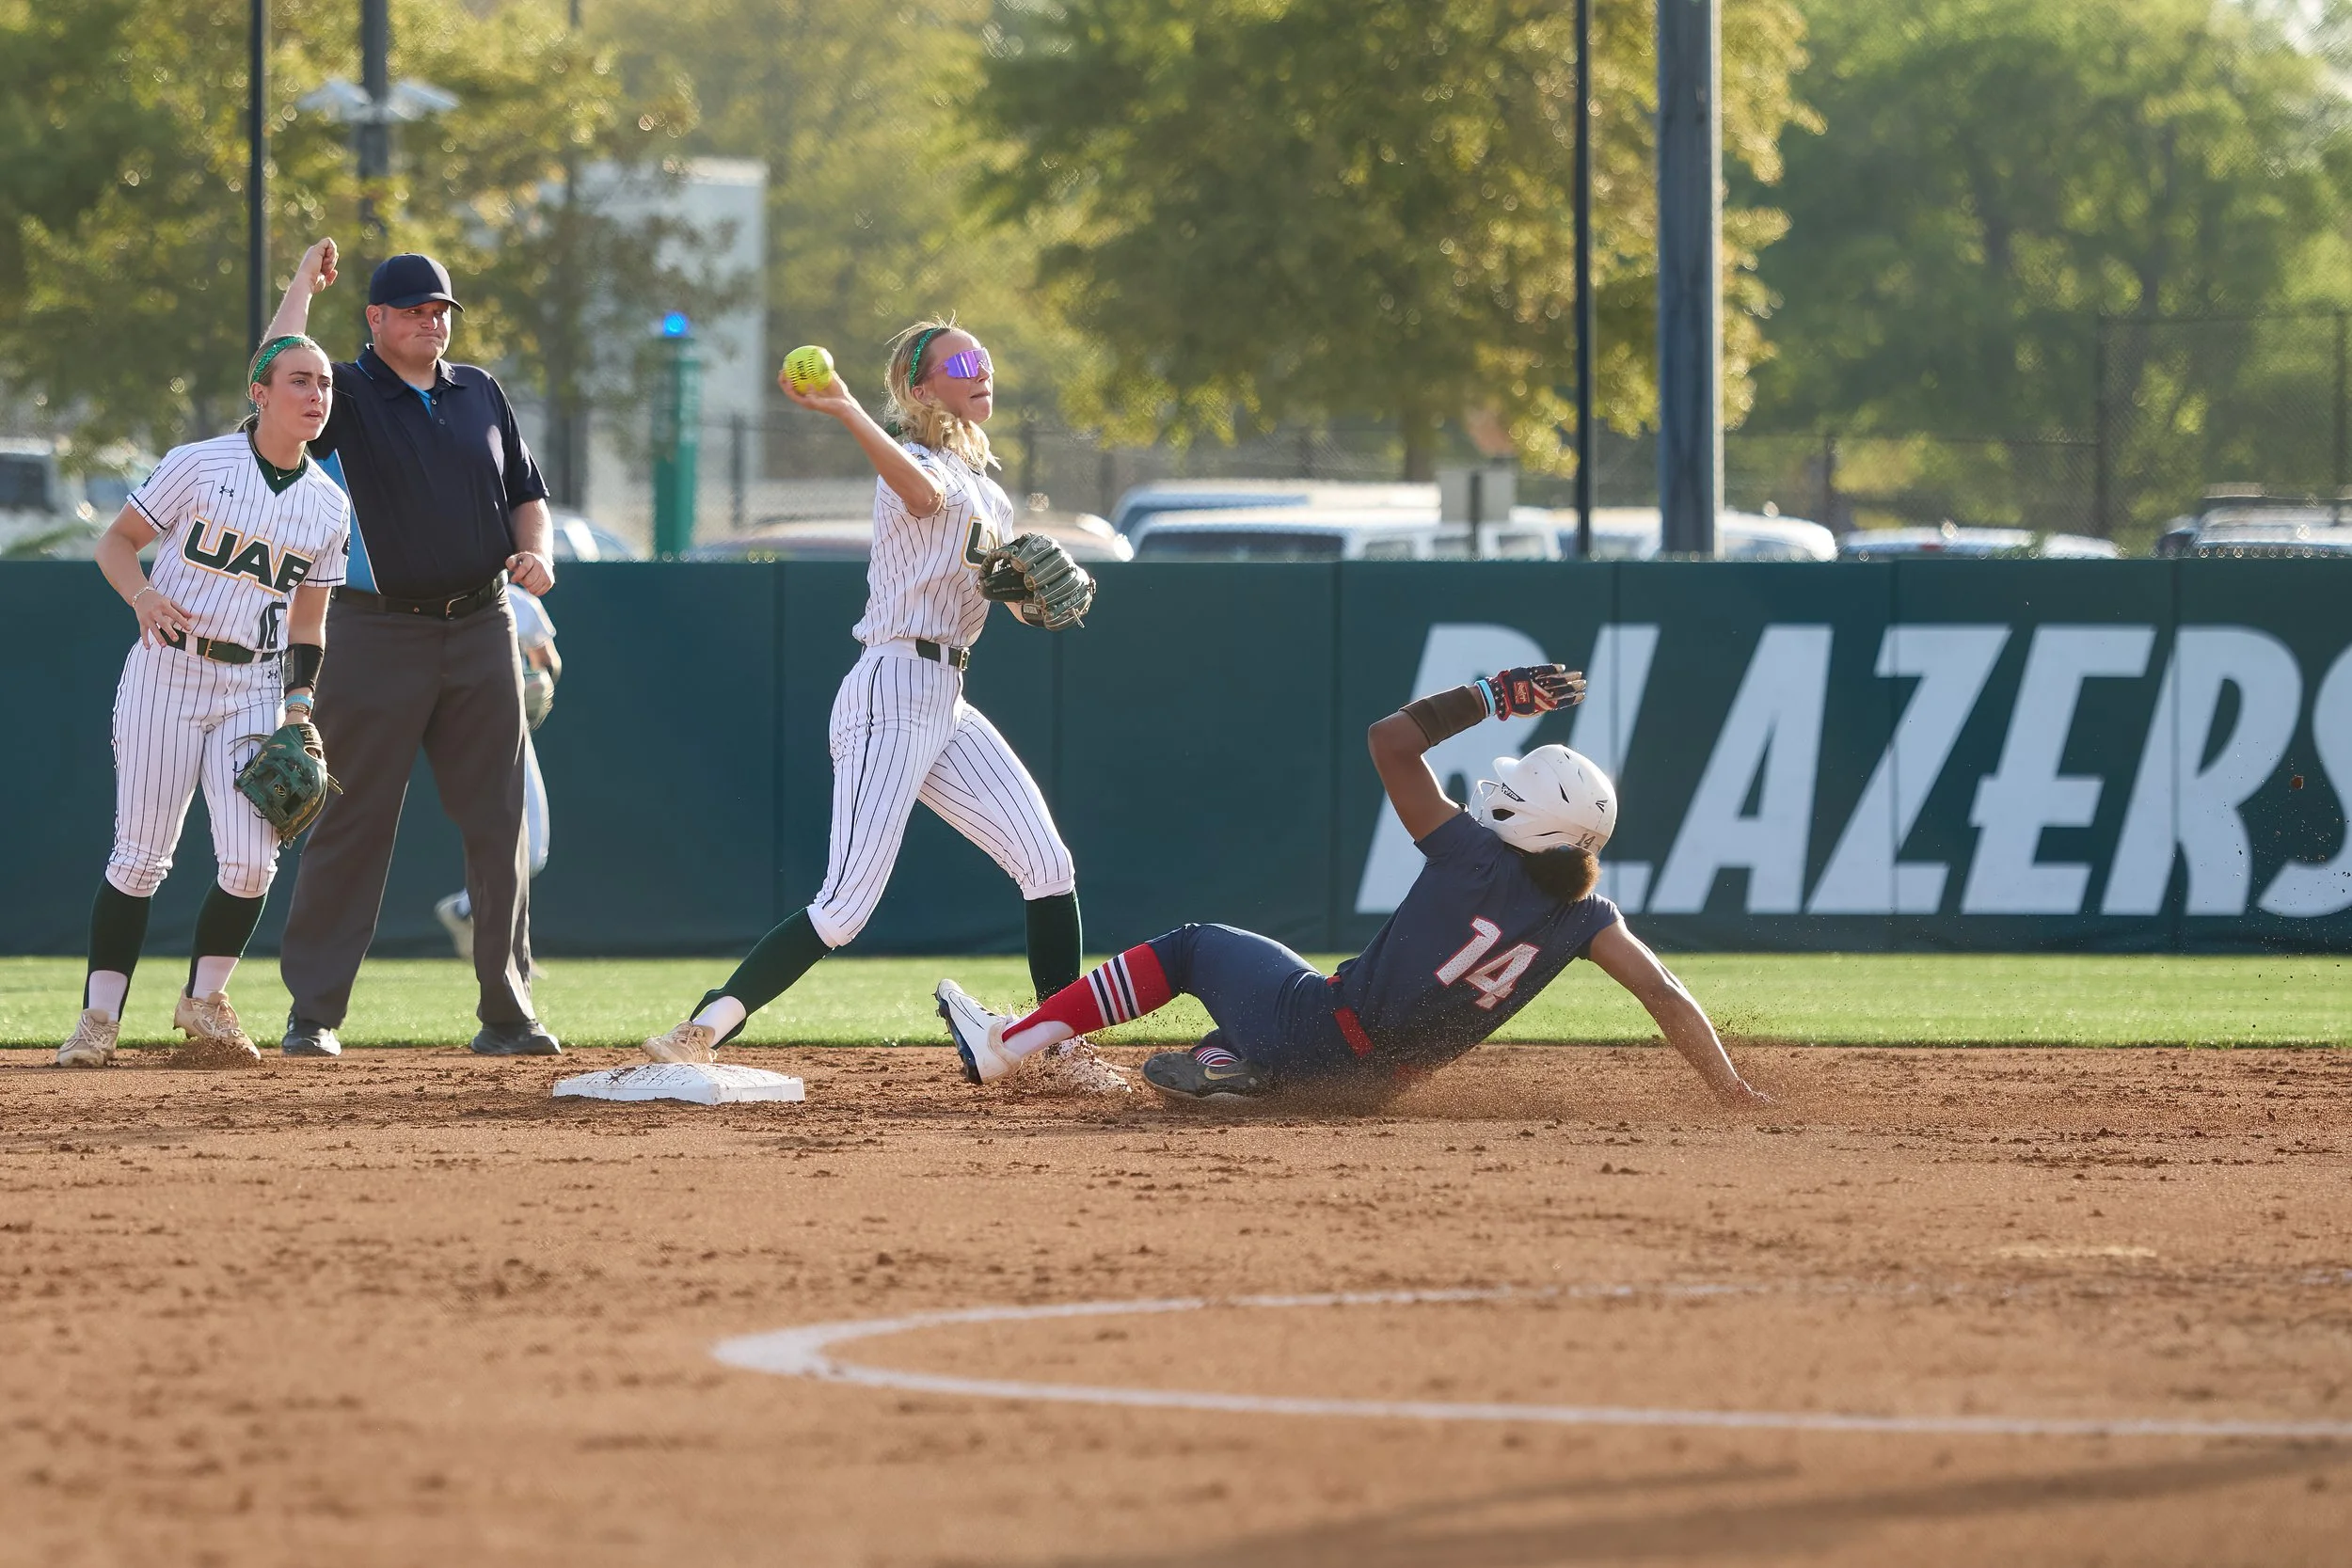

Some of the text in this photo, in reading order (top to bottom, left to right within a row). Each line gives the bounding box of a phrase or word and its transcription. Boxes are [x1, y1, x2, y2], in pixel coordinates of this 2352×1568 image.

[181, 515, 316, 597] UAB
[1575, 833, 1597, 849] 14
[1434, 915, 1541, 1011] 14
